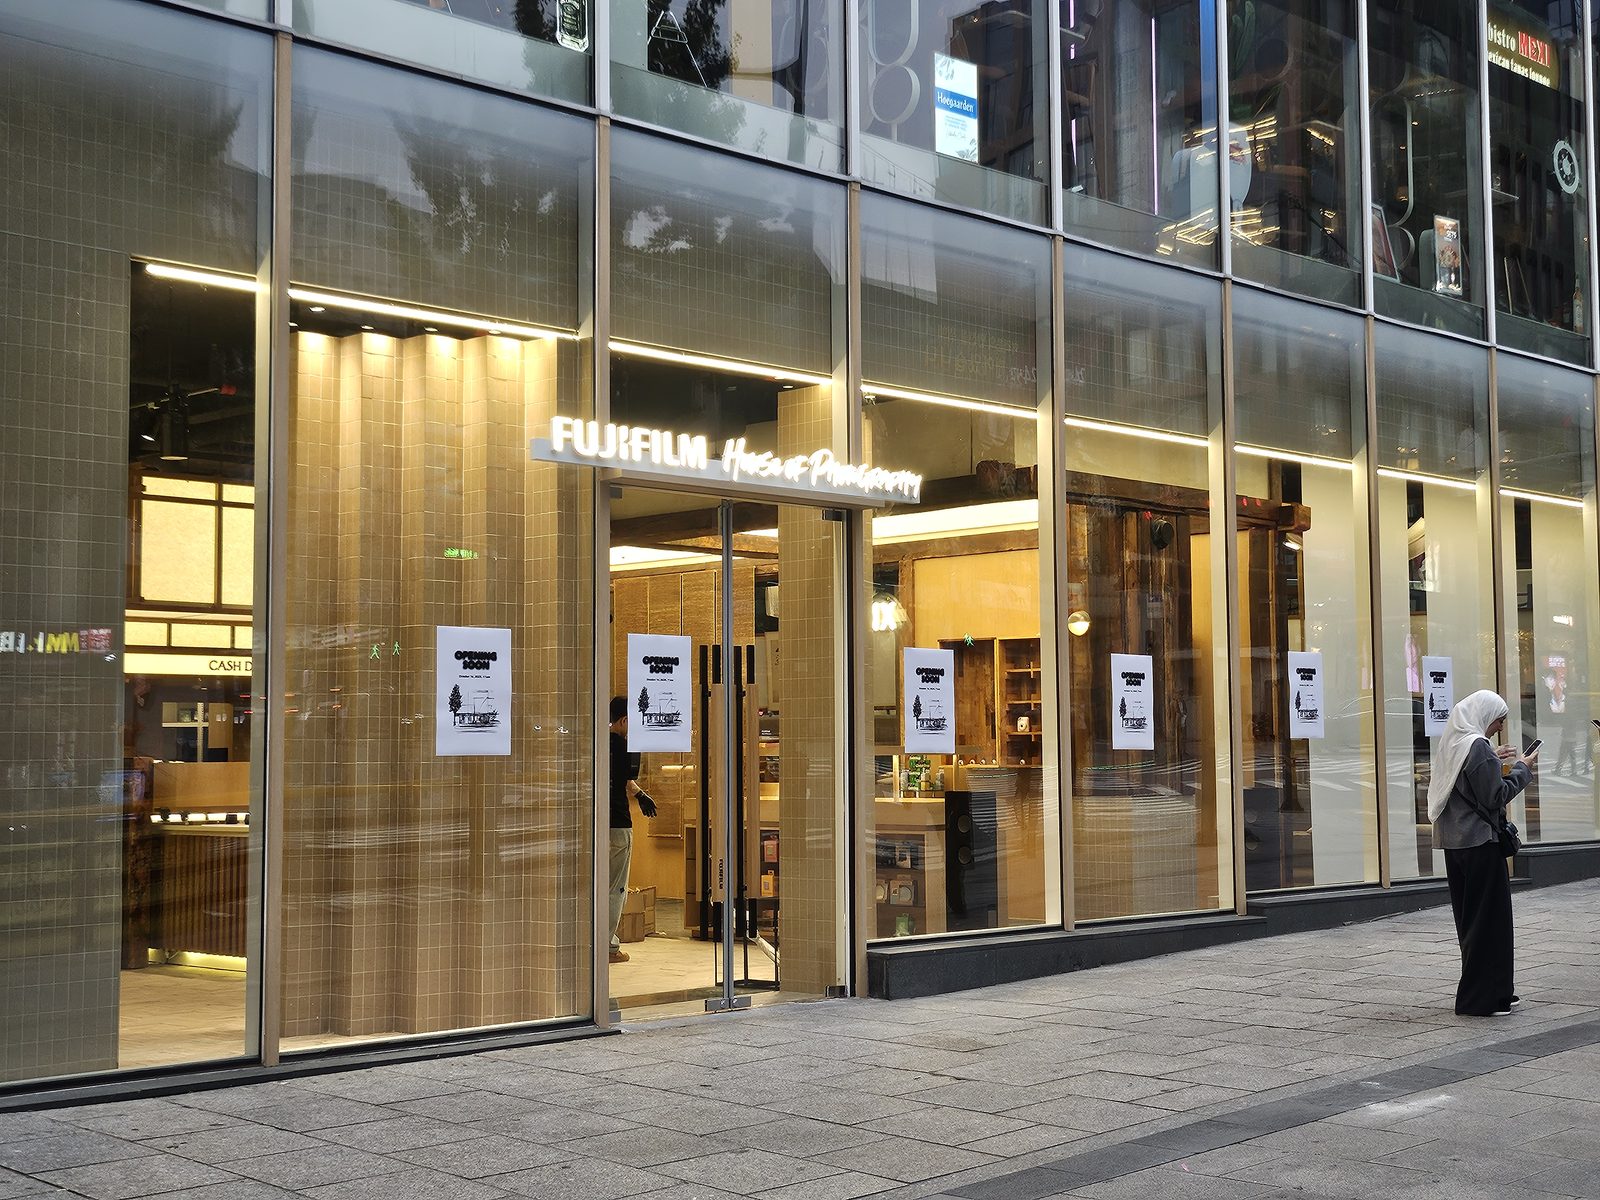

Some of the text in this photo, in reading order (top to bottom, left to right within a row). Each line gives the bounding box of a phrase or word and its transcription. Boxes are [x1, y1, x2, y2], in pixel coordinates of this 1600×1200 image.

[1487, 22, 1516, 52] bistro
[1487, 51, 1510, 70] exican
[937, 92, 974, 113] Hoegaarden
[551, 416, 707, 470] FUJIFILM
[208, 660, 241, 671] CASH
[454, 651, 497, 661] OPENING
[462, 660, 490, 670] SOON
